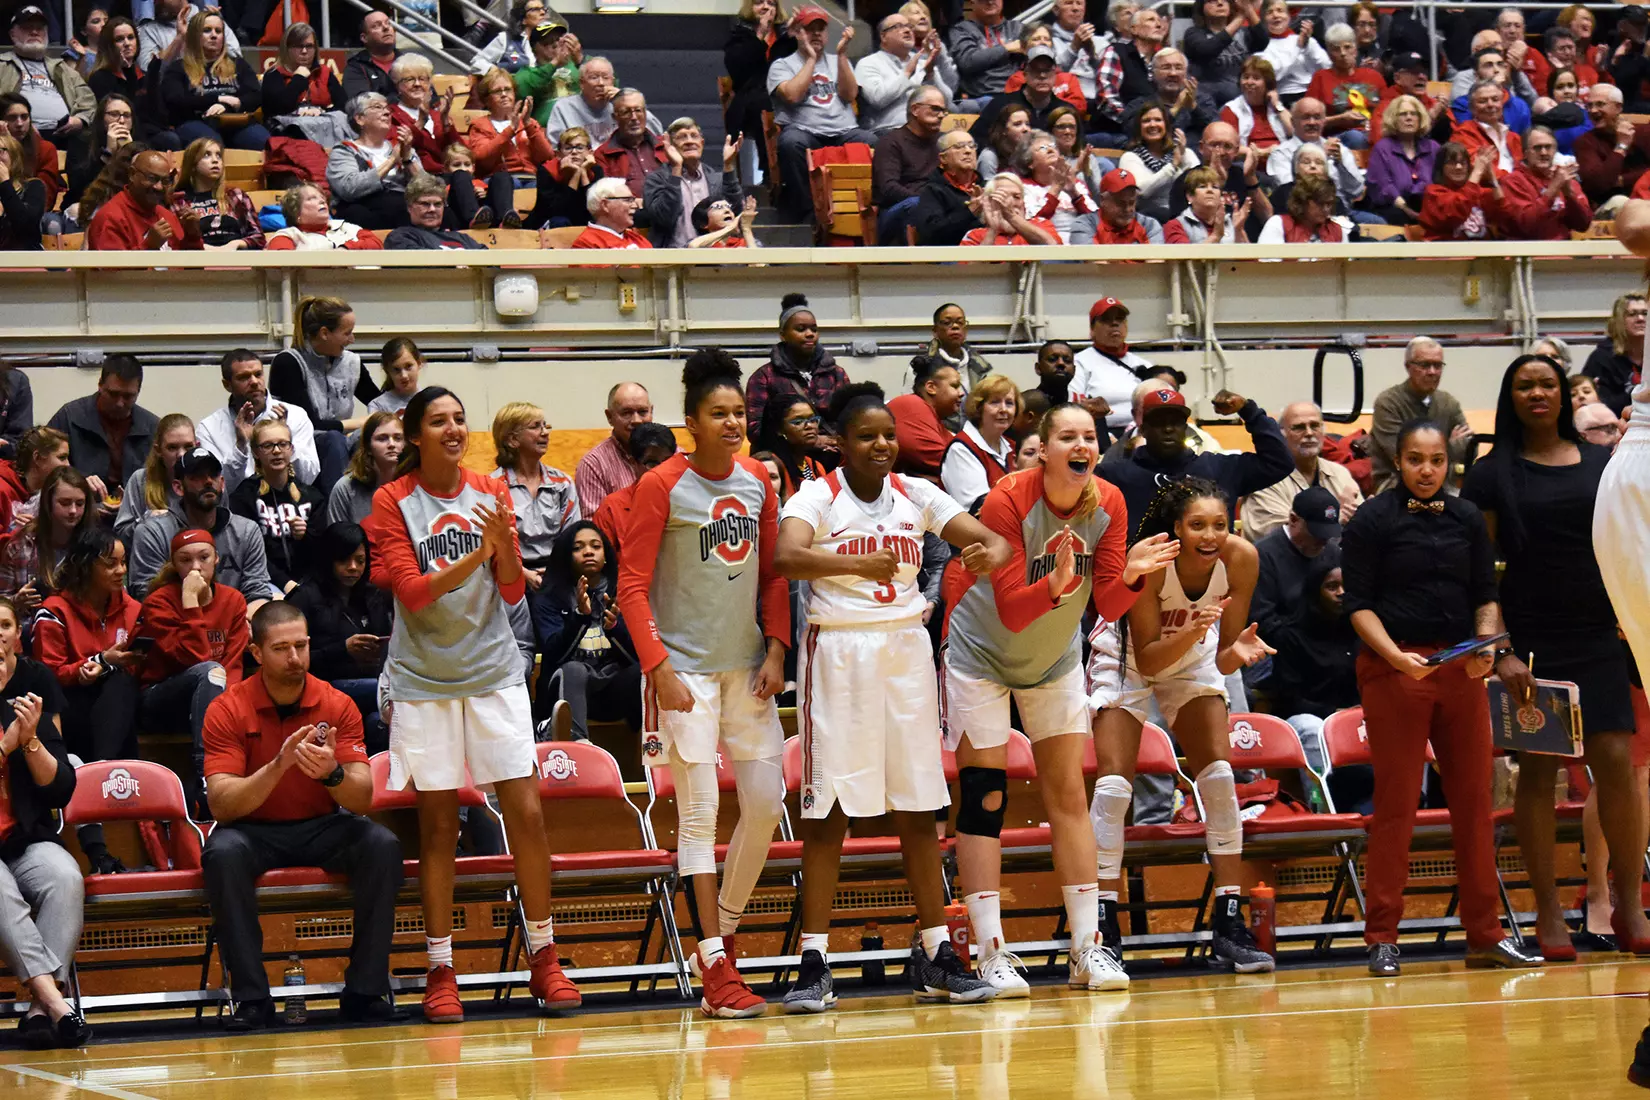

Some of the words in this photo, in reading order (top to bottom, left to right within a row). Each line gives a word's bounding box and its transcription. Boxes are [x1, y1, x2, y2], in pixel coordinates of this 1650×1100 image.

[952, 118, 968, 130] 30
[488, 233, 497, 245] 3
[1500, 692, 1510, 714] OHIO
[1503, 714, 1513, 740] STATE
[953, 926, 969, 945] G
